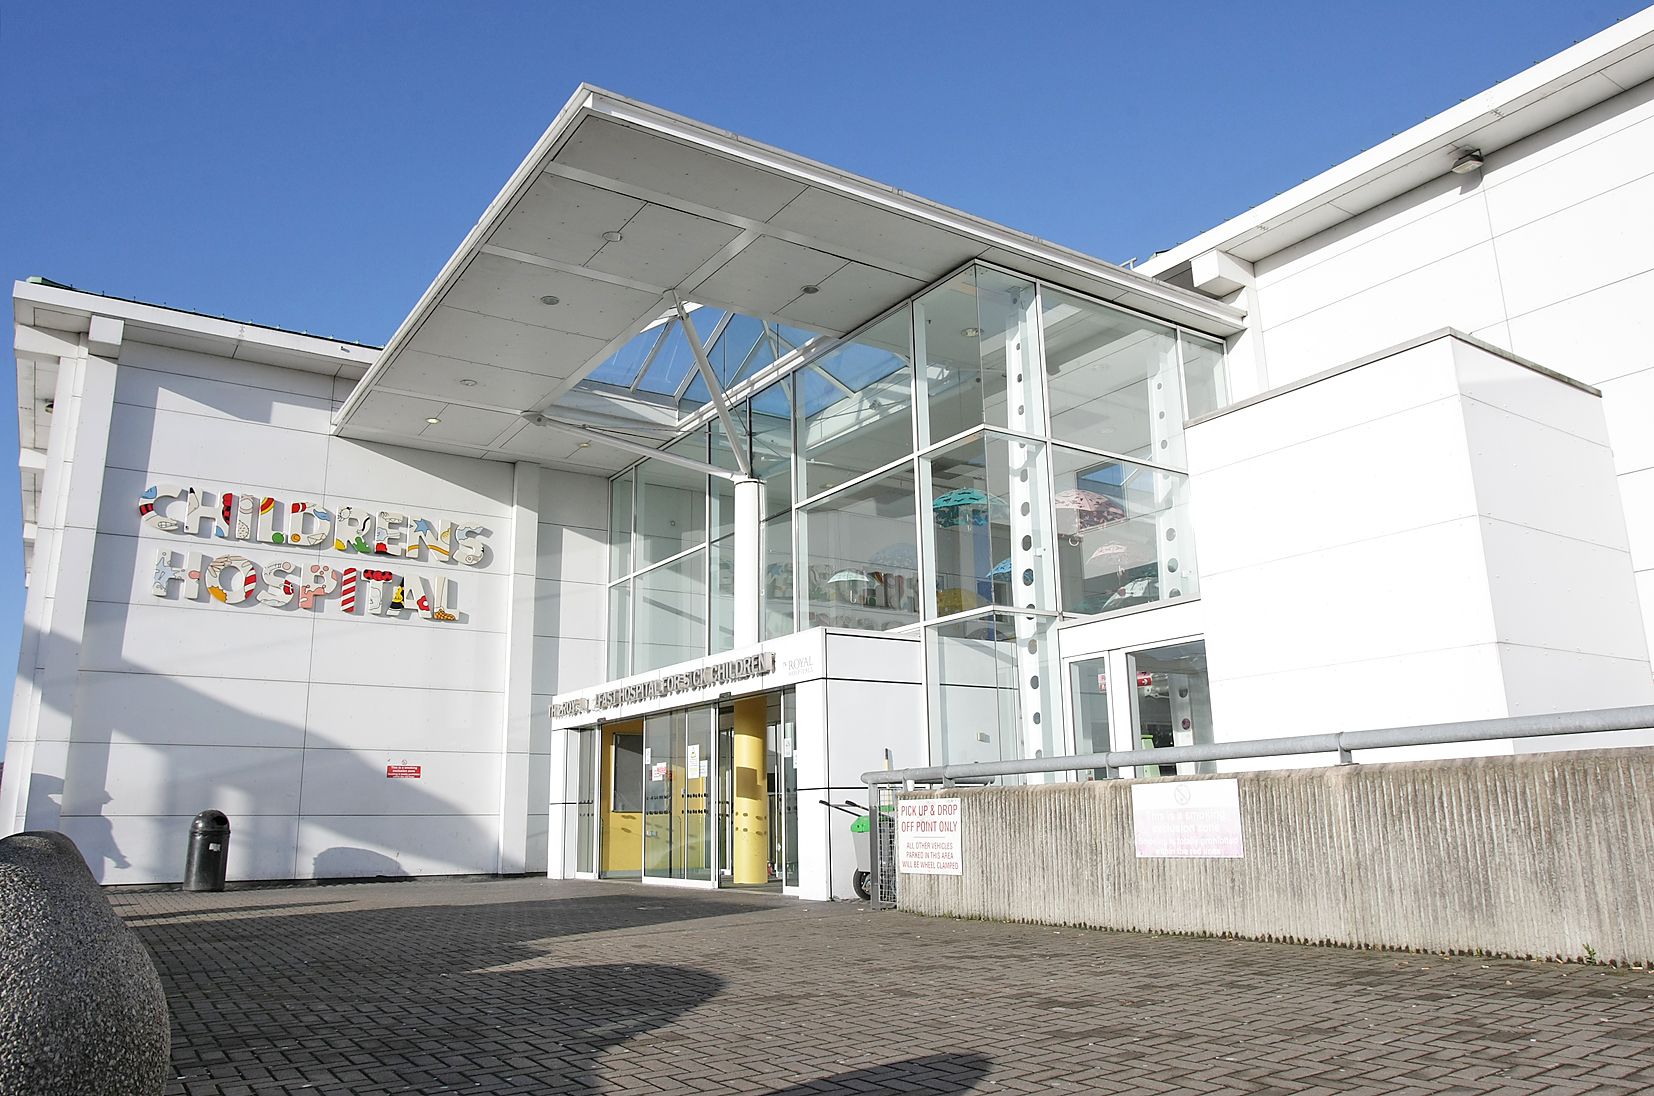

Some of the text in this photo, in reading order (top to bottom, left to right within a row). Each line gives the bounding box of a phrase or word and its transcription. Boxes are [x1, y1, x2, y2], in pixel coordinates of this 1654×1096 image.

[139, 484, 494, 566] CHILDRENS
[151, 547, 463, 622] HOSPITAL
[788, 655, 813, 671] ROYAL
[620, 680, 659, 704] HOSPITAL
[662, 674, 682, 693] FOR
[683, 668, 706, 689] SICK
[711, 652, 767, 682] CHILDREN
[901, 804, 958, 816] PICK UP & DROP
[901, 821, 958, 832] OFF POINT ONLY
[906, 842, 953, 850] ALL OTHER VEHICLES
[906, 851, 953, 859] PARKED IN THIS AREA
[902, 860, 959, 870] WILL BE WHEEL CLAMPED
